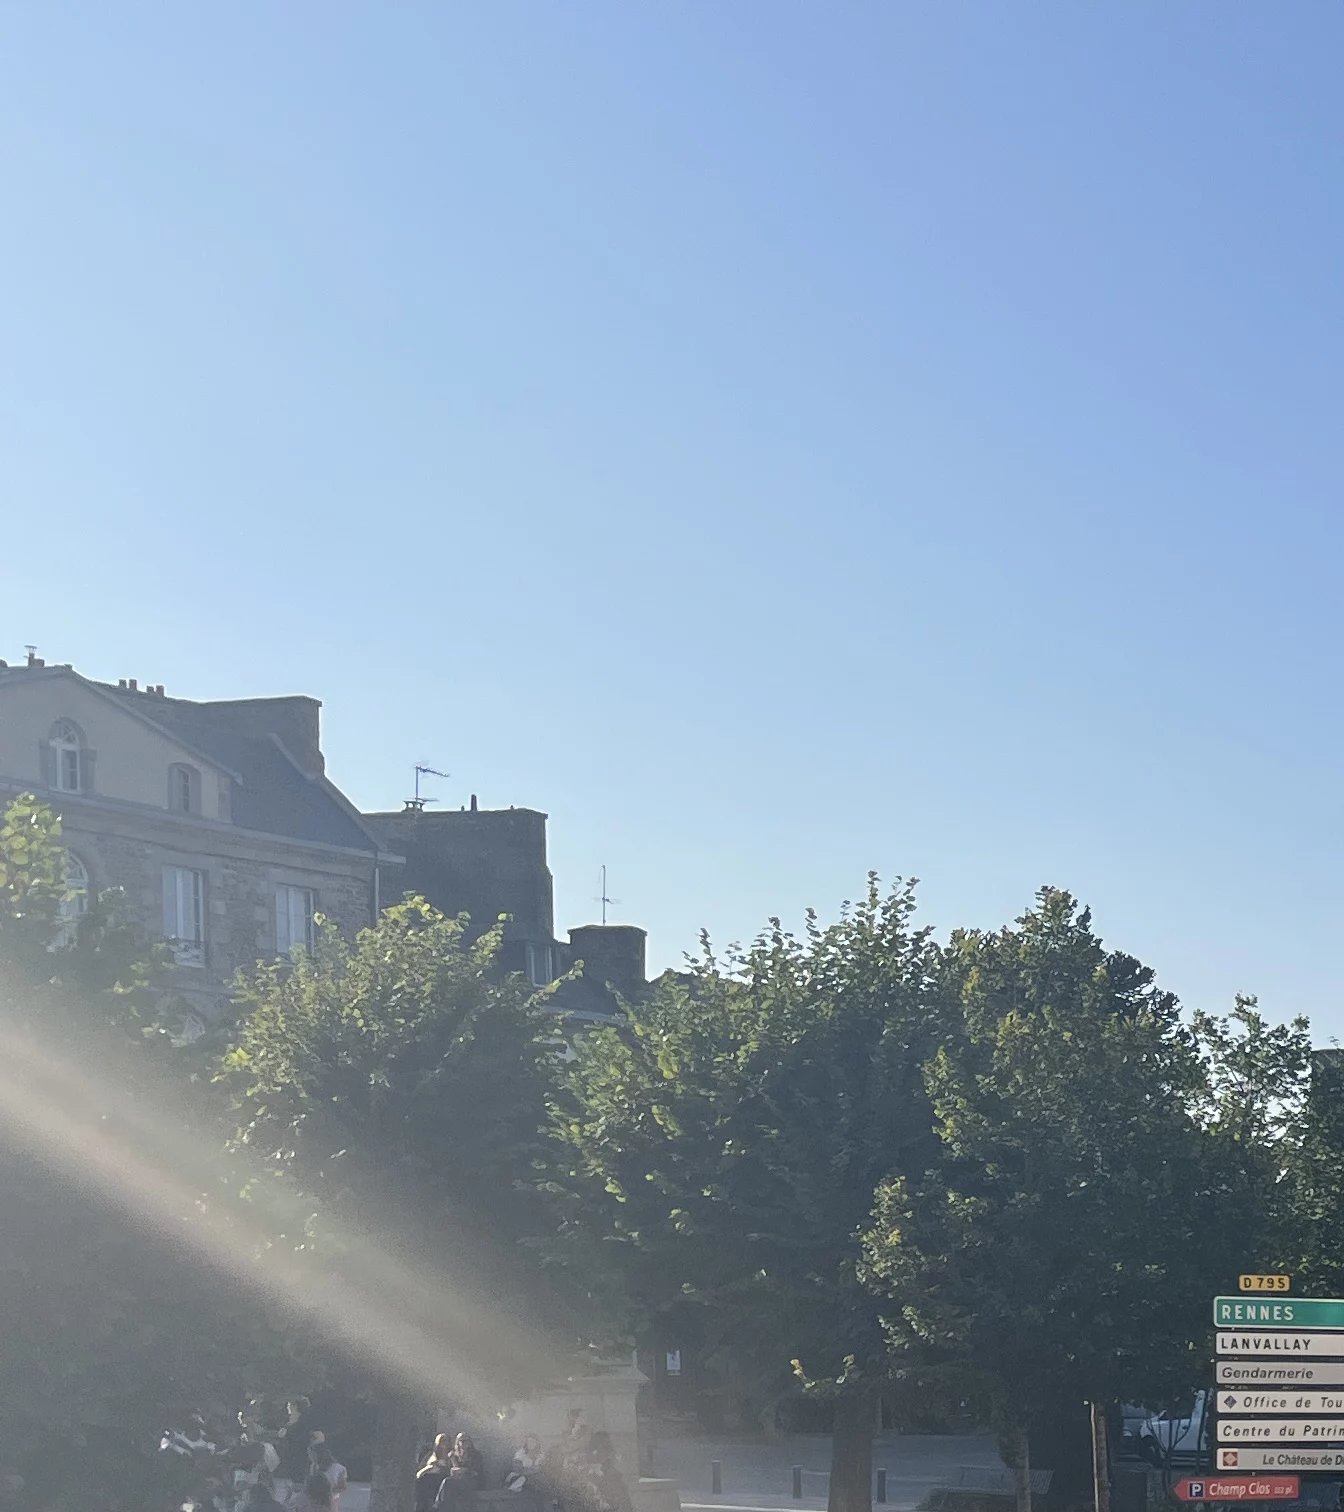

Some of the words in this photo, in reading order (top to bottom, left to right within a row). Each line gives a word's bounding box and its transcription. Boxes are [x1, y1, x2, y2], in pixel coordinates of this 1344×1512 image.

[1243, 1277, 1252, 1289] D
[1257, 1277, 1286, 1289] 795
[1221, 1304, 1294, 1321] RENNES
[1221, 1337, 1311, 1351] LANVALLAY
[1222, 1366, 1314, 1380] Gendarmerie
[1243, 1396, 1287, 1409] Office
[1295, 1397, 1312, 1409] de
[1223, 1425, 1271, 1437] Centre
[1279, 1425, 1296, 1437] du
[1262, 1454, 1275, 1466] Le
[1277, 1453, 1319, 1466] Château
[1320, 1454, 1333, 1466] de
[1208, 1483, 1246, 1499] Champ
[1248, 1481, 1271, 1495] Clos
